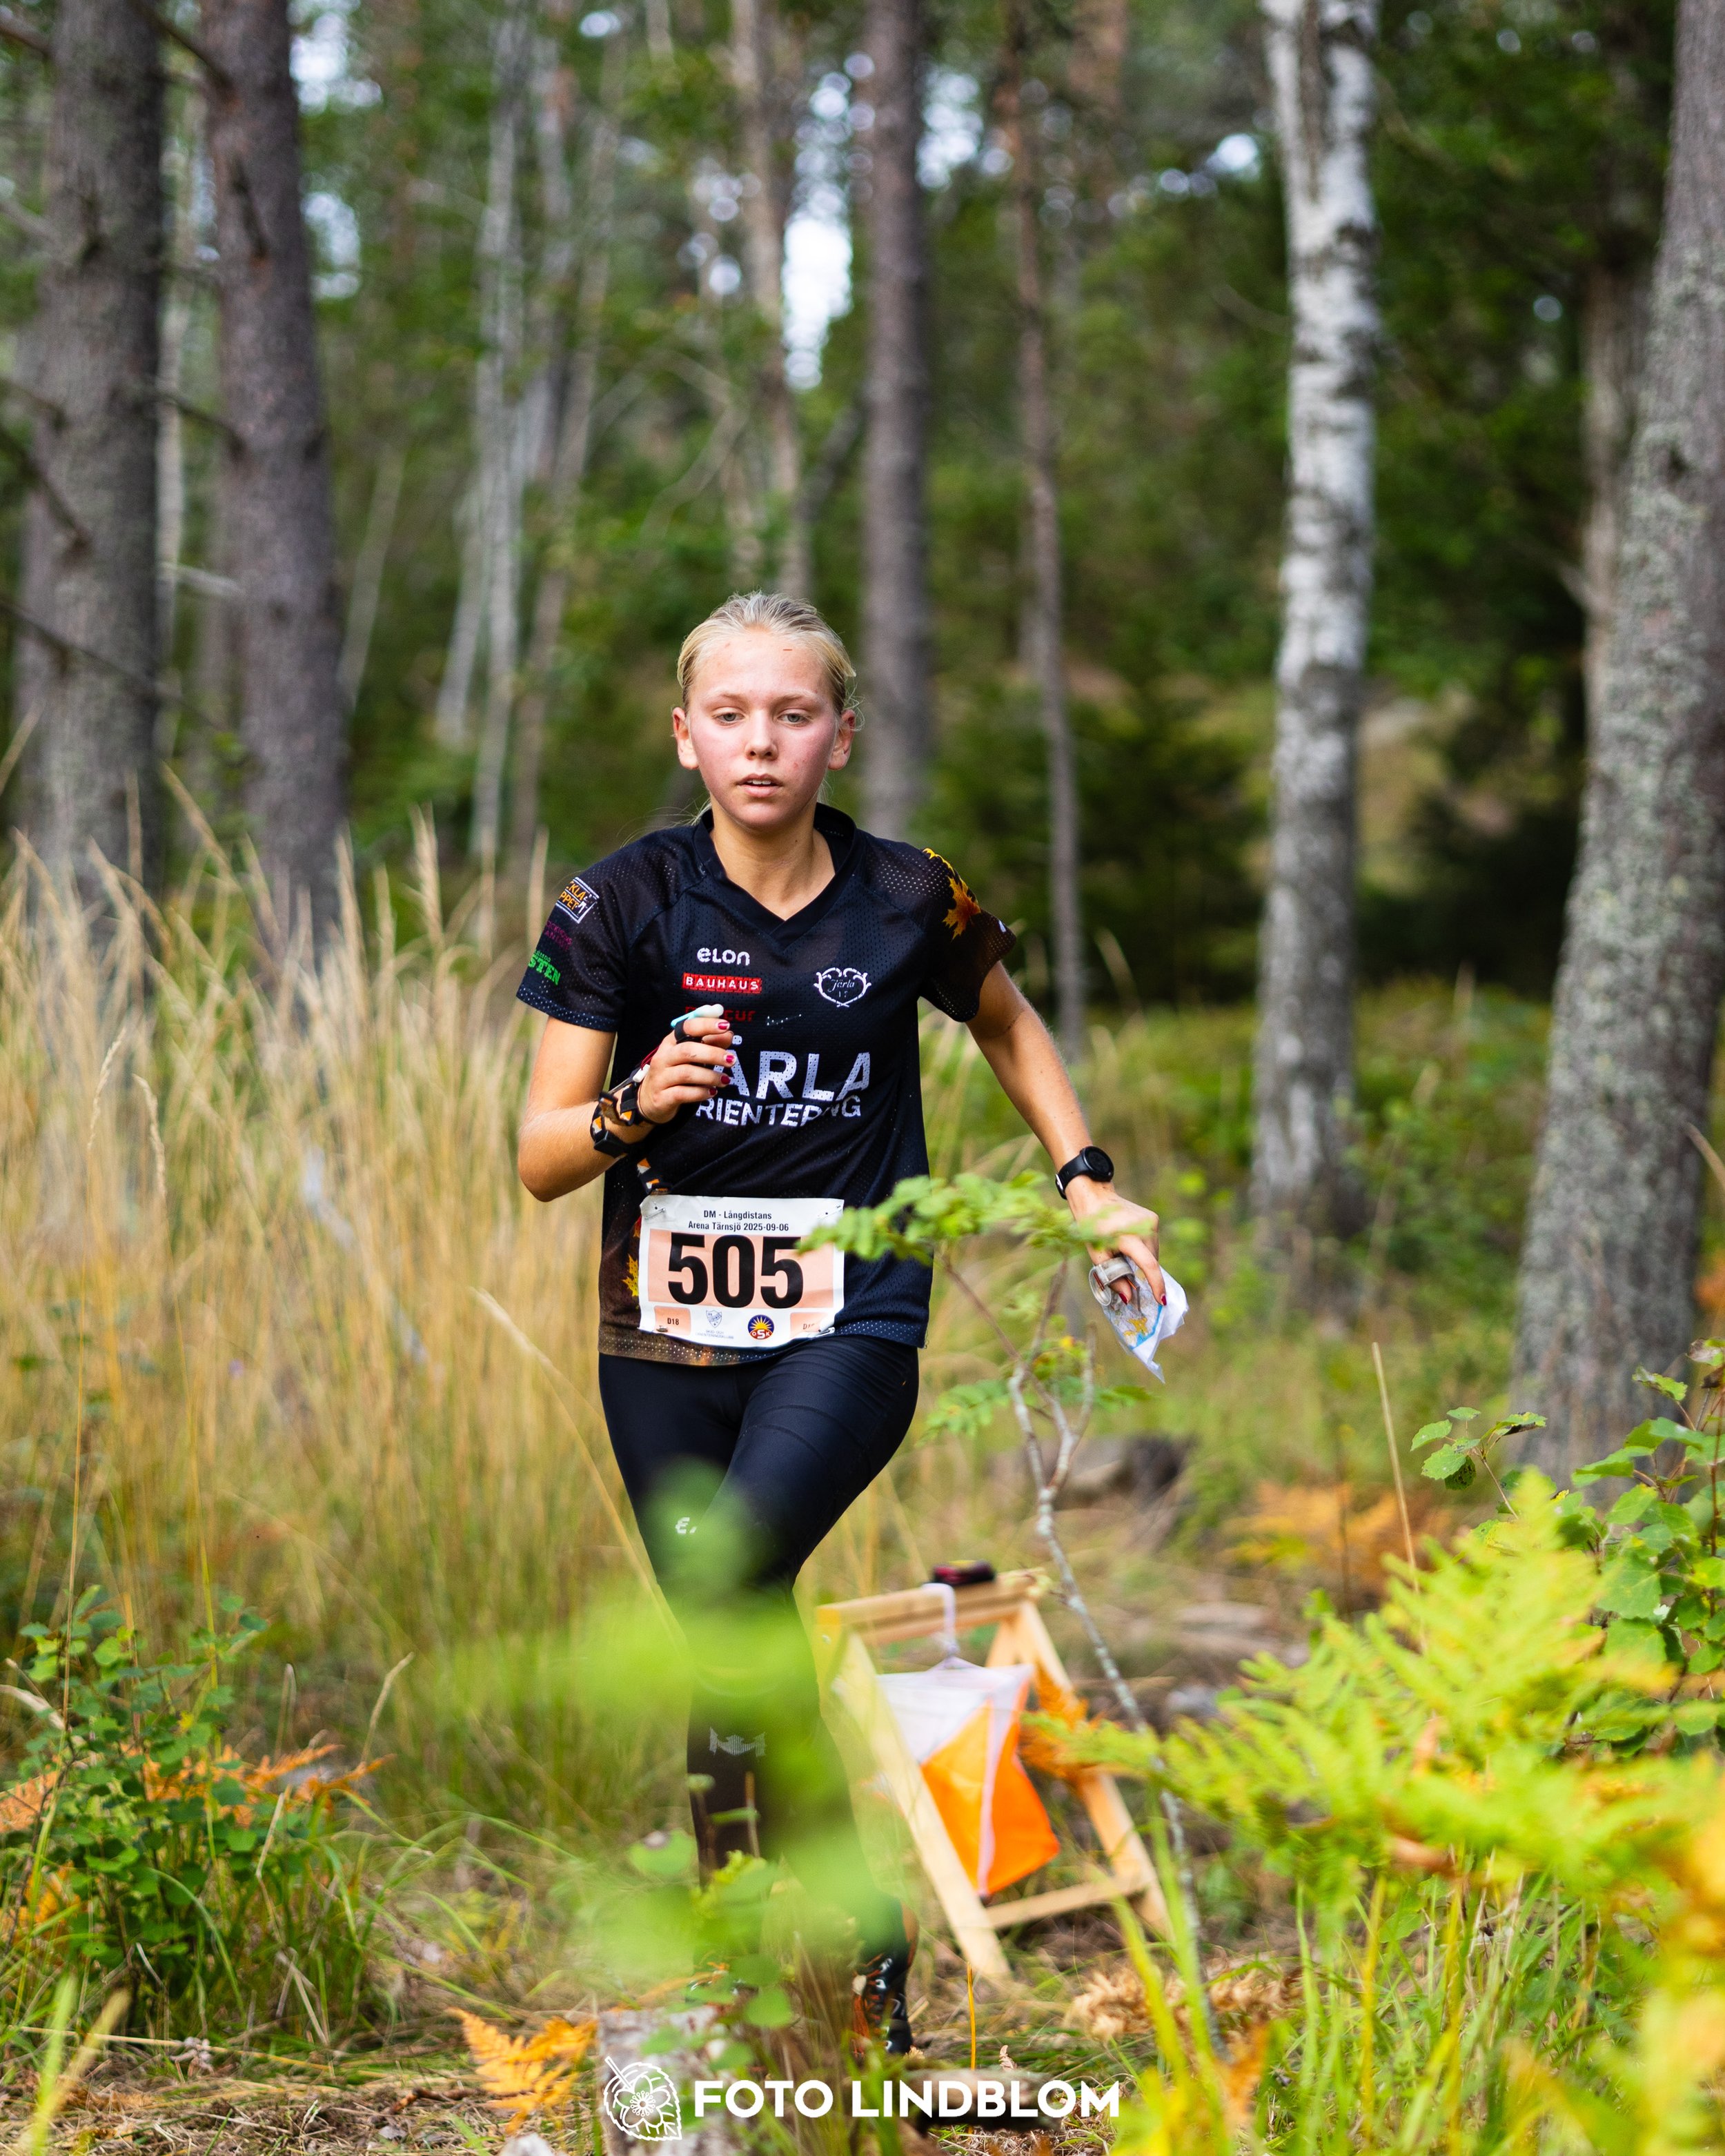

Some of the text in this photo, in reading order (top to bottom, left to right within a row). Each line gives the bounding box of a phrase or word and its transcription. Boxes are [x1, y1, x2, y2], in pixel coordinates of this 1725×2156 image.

[559, 891, 580, 910] PPET
[528, 953, 562, 986] STEN
[685, 976, 759, 990] BAUHAUS
[713, 1035, 871, 1102] ÄRLA
[724, 1211, 772, 1220] Långdistans
[688, 1220, 789, 1232] Arena Tärnsjö 2025-09-06
[668, 1232, 804, 1309] 505
[667, 1317, 680, 1326] D18
[751, 1329, 770, 1339] OSK
